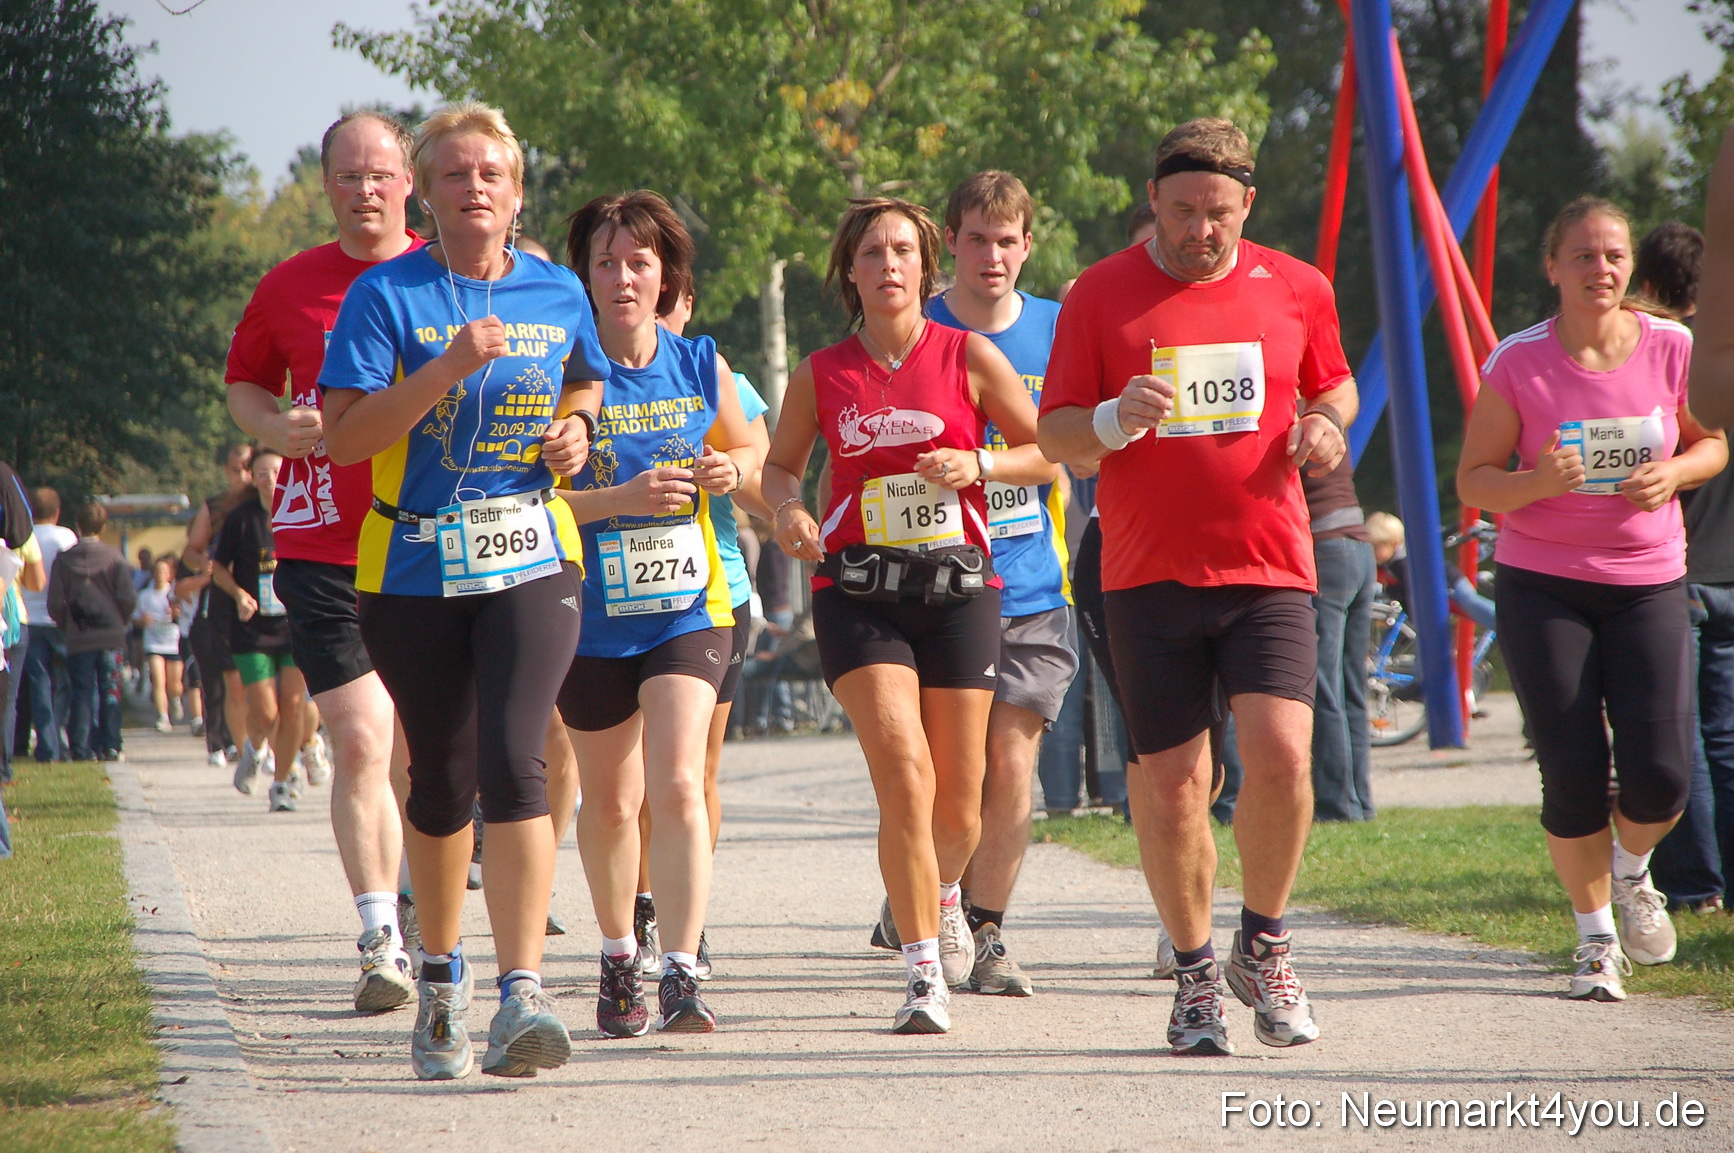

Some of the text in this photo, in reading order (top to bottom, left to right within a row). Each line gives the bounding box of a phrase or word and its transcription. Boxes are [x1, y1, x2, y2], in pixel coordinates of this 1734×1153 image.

[415, 322, 567, 343] 10. NARKTER
[1187, 377, 1255, 405] 1038
[601, 396, 704, 420] NEUMARKTER
[489, 422, 547, 437] 20.09.20
[599, 413, 688, 436] STADTLAUF
[1590, 427, 1624, 440] Maria
[1592, 447, 1652, 469] 2508
[314, 462, 341, 525] MAX
[887, 480, 926, 498] Nicole
[866, 510, 873, 521] D
[900, 502, 947, 529] 185
[446, 537, 454, 549] D
[475, 527, 539, 559] 2969
[629, 535, 674, 552] Andrea
[515, 561, 558, 579] PFLEIDERER
[608, 564, 615, 576] D
[633, 556, 697, 584] 2274
